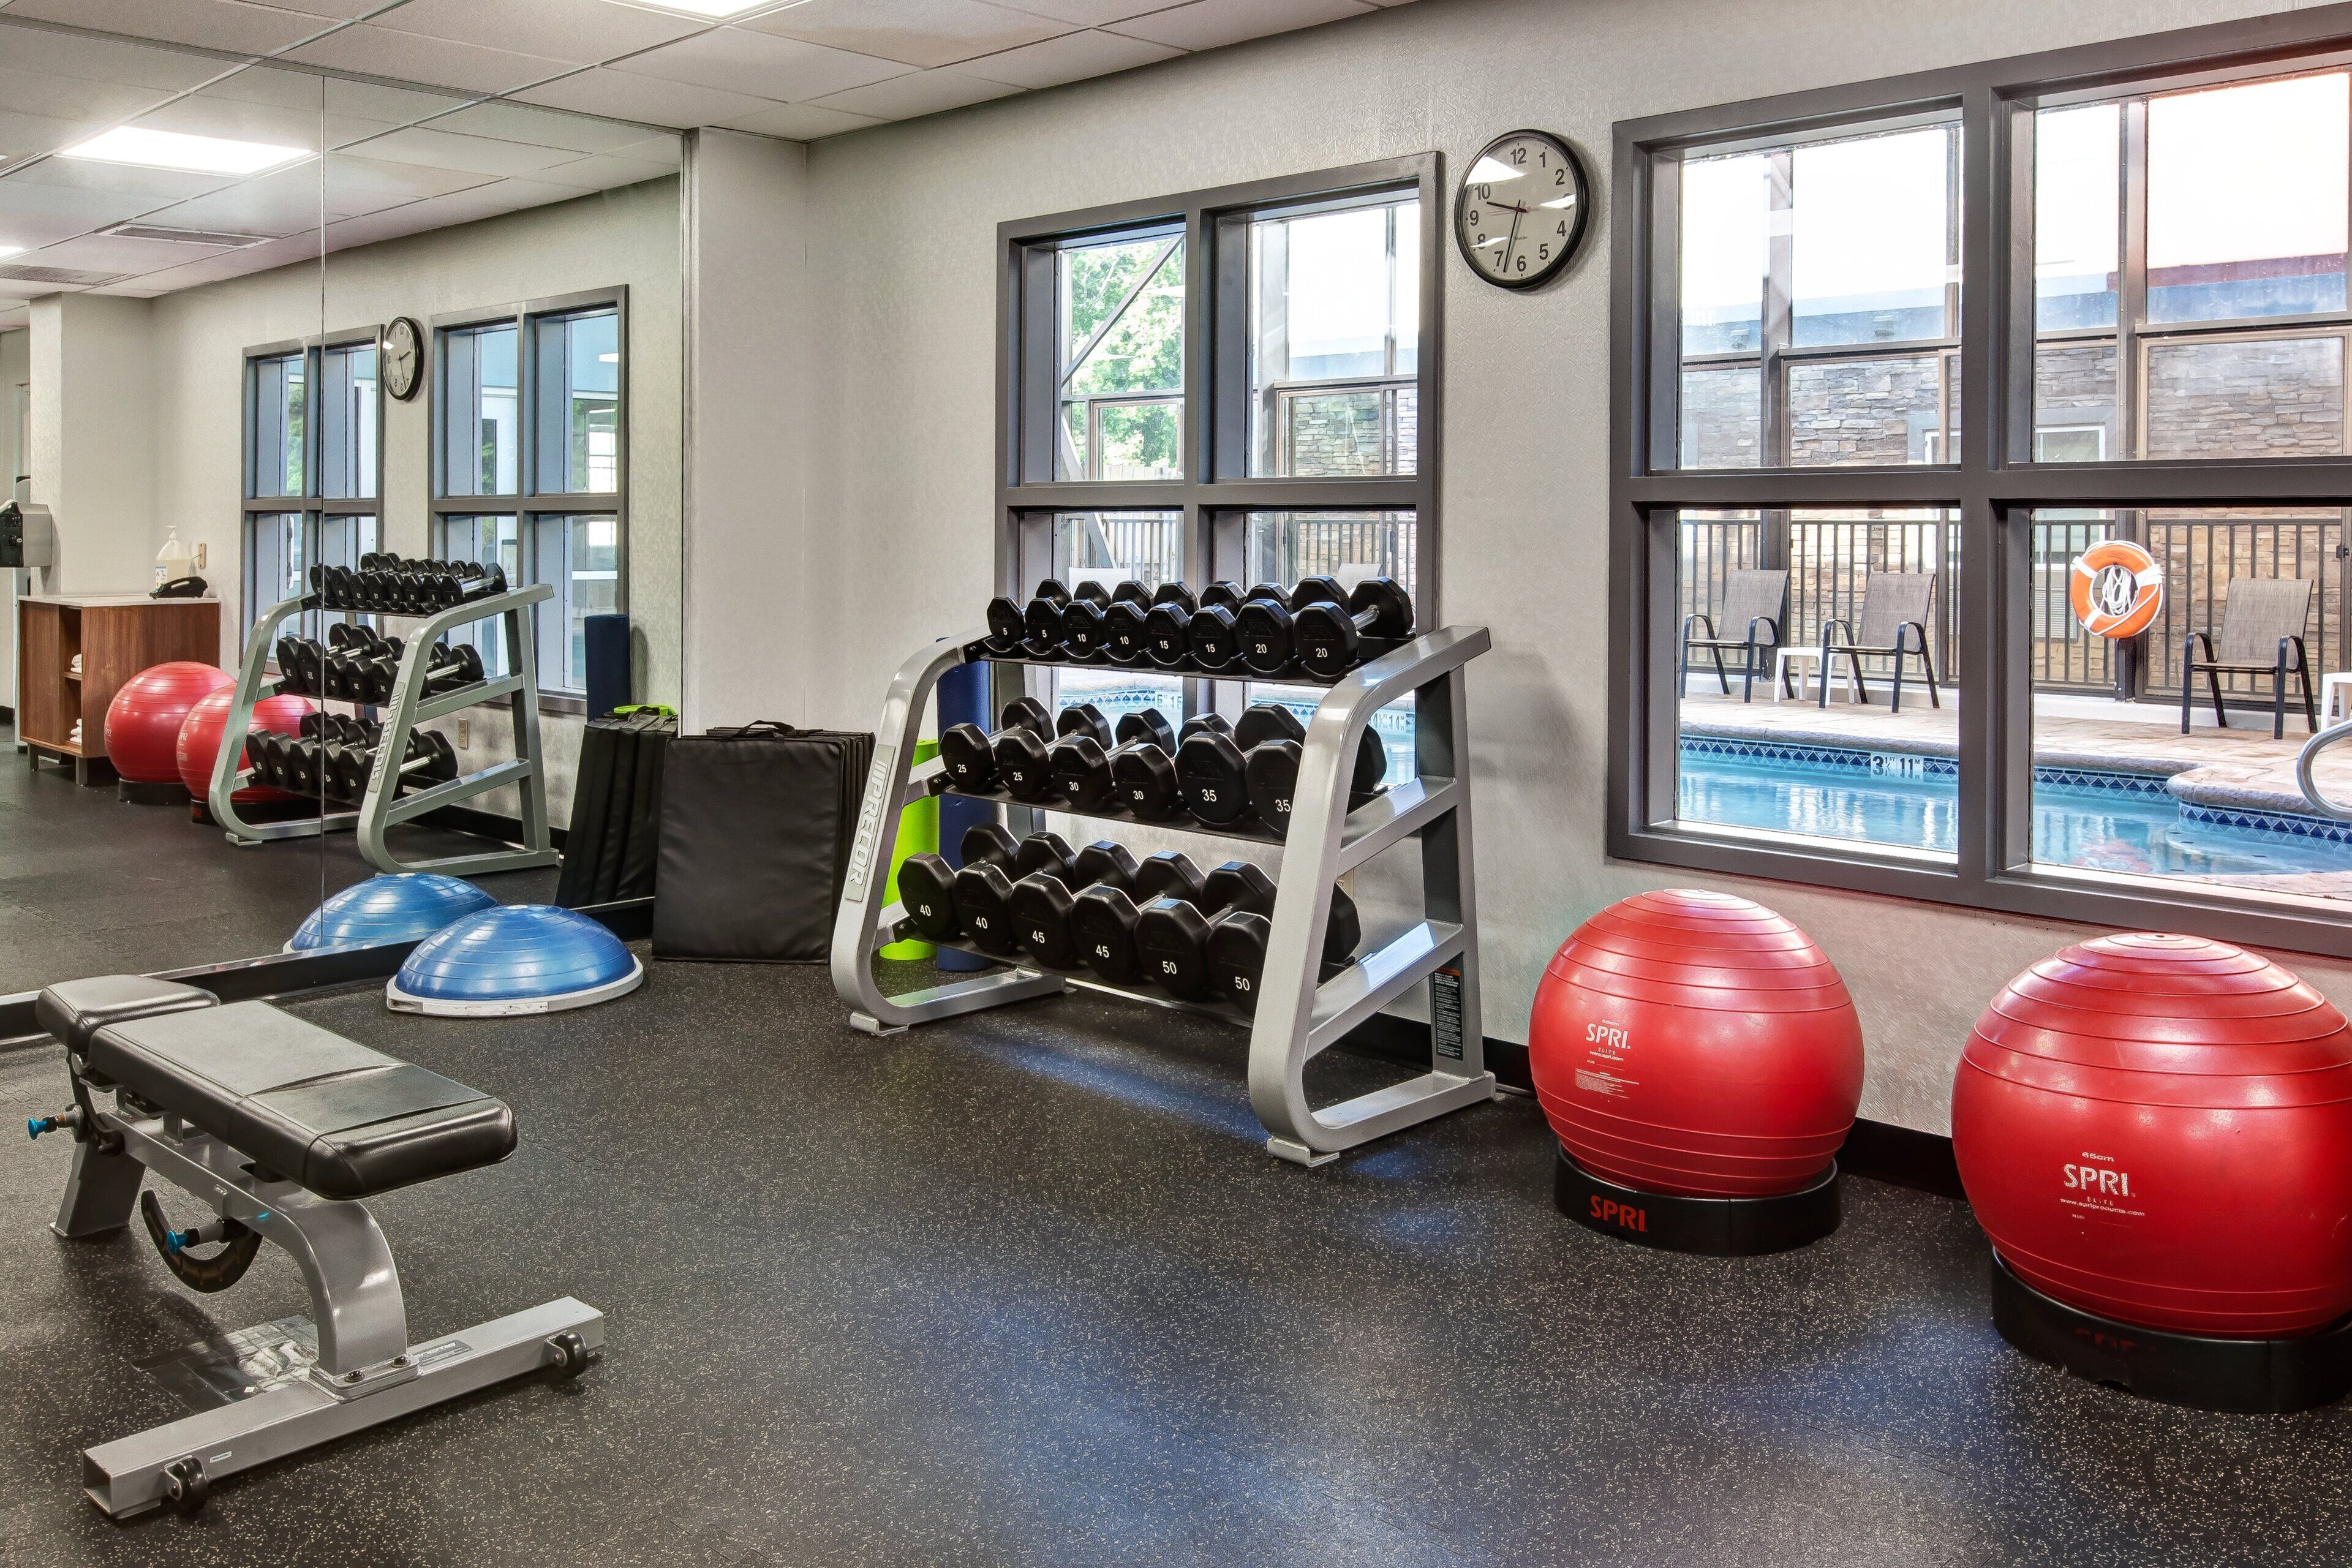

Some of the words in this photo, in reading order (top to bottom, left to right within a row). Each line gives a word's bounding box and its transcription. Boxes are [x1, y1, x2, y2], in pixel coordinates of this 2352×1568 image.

[1510, 148, 1527, 165] 12
[1539, 151, 1546, 168] 1
[1555, 168, 1565, 186] 2
[1475, 184, 1491, 200] 10
[1469, 210, 1479, 226] 9
[1556, 221, 1566, 236] 4
[1539, 243, 1549, 260] 5
[1494, 250, 1504, 267] 7
[1517, 255, 1526, 271] 6
[1003, 627, 1008, 636] 5
[1042, 630, 1047, 638] 5
[1077, 633, 1087, 643] 10
[1120, 636, 1129, 645] 10
[1159, 641, 1169, 650] 15
[1205, 644, 1215, 653] 15
[1256, 644, 1267, 654] 20
[1316, 648, 1328, 658] 20
[957, 764, 967, 774] 25
[1013, 772, 1023, 782] 25
[1069, 782, 1079, 791] 30
[1133, 791, 1144, 800] 30
[1202, 788, 1217, 802] 35
[1275, 799, 1291, 812] 35
[850, 775, 886, 886] PRECOR
[920, 905, 931, 917] 40
[976, 917, 987, 929] 40
[1033, 930, 1045, 944] 45
[1096, 944, 1109, 959] 45
[1163, 960, 1177, 975] 50
[1235, 976, 1250, 991] 50
[1598, 1047, 1616, 1055] ELITE
[2087, 1196, 2114, 1206] ELITE
[1590, 1195, 1646, 1232] SPRI
